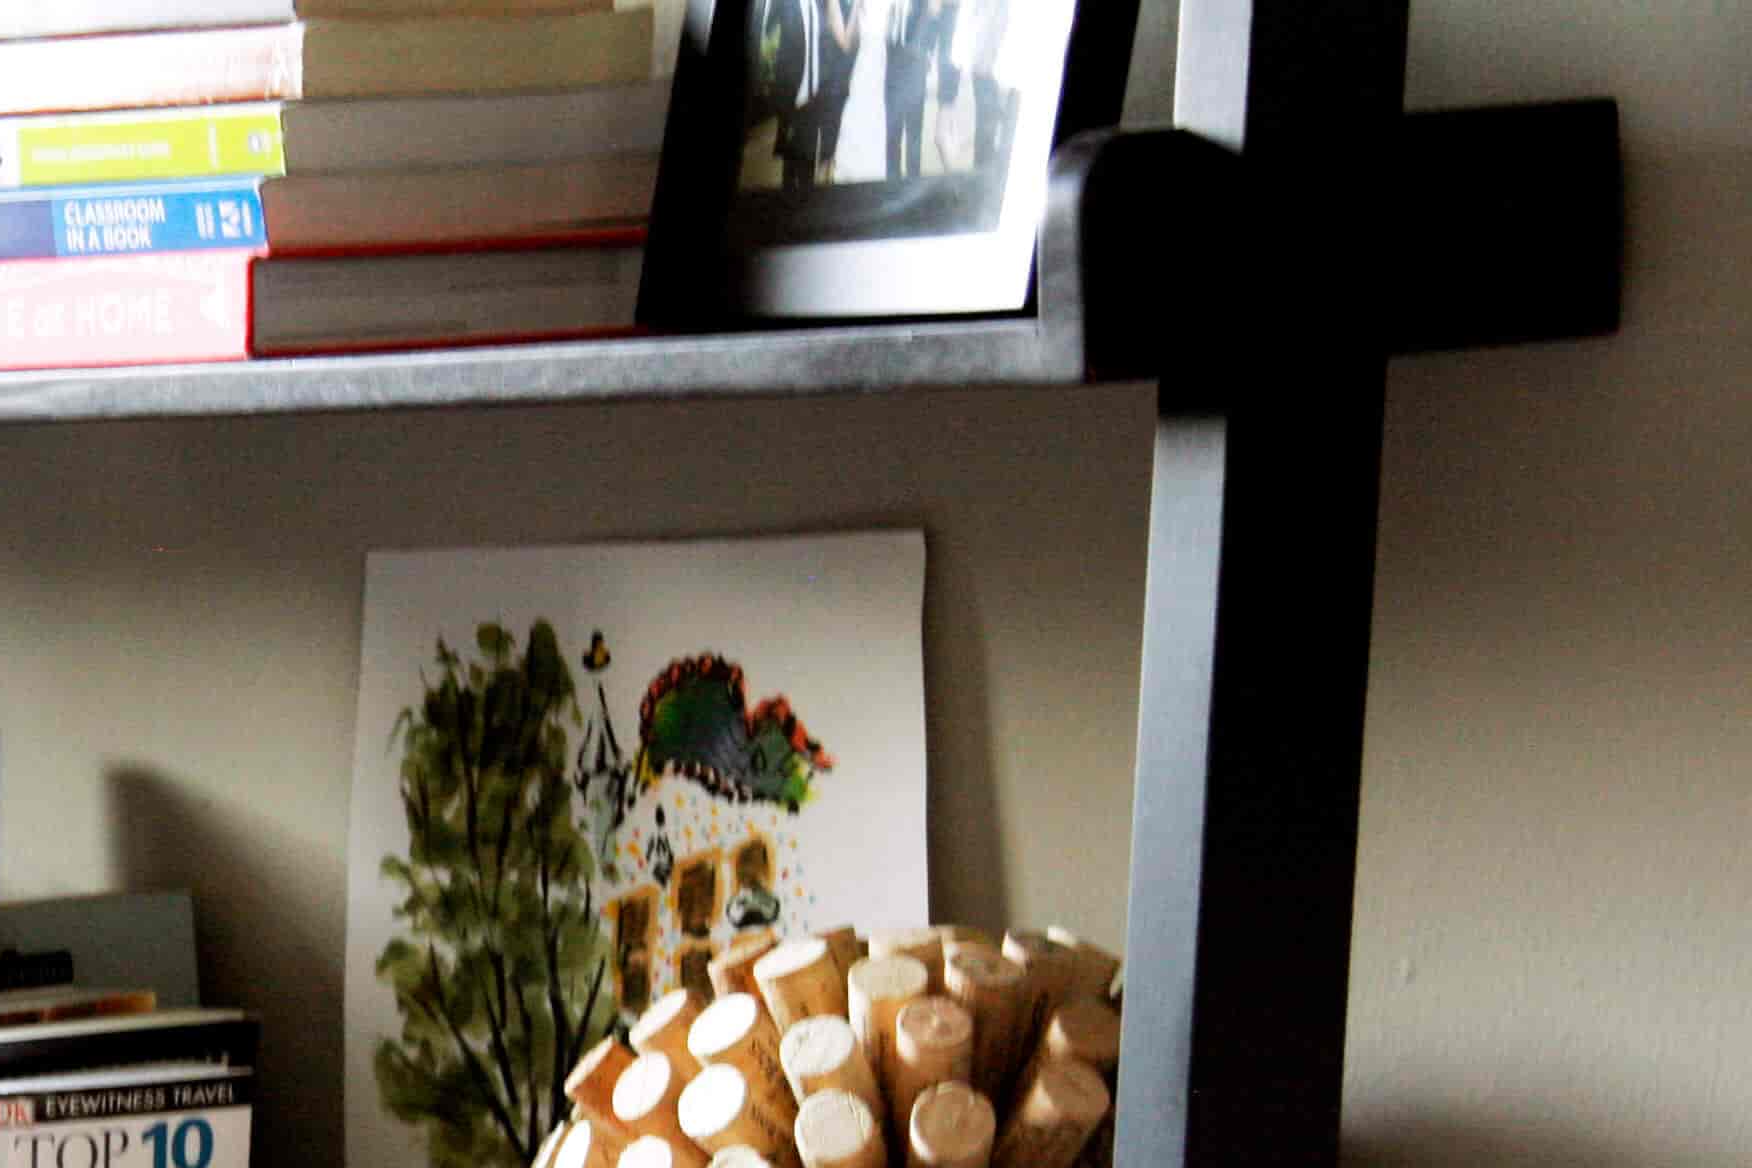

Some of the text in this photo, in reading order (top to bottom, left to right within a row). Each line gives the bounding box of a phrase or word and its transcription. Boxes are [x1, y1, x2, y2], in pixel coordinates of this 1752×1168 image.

[64, 197, 166, 226] CLASSROOM
[66, 223, 153, 252] IN A BOOK
[71, 288, 177, 337] HOME
[44, 1083, 234, 1118] EYEWITNESS TRAVEL
